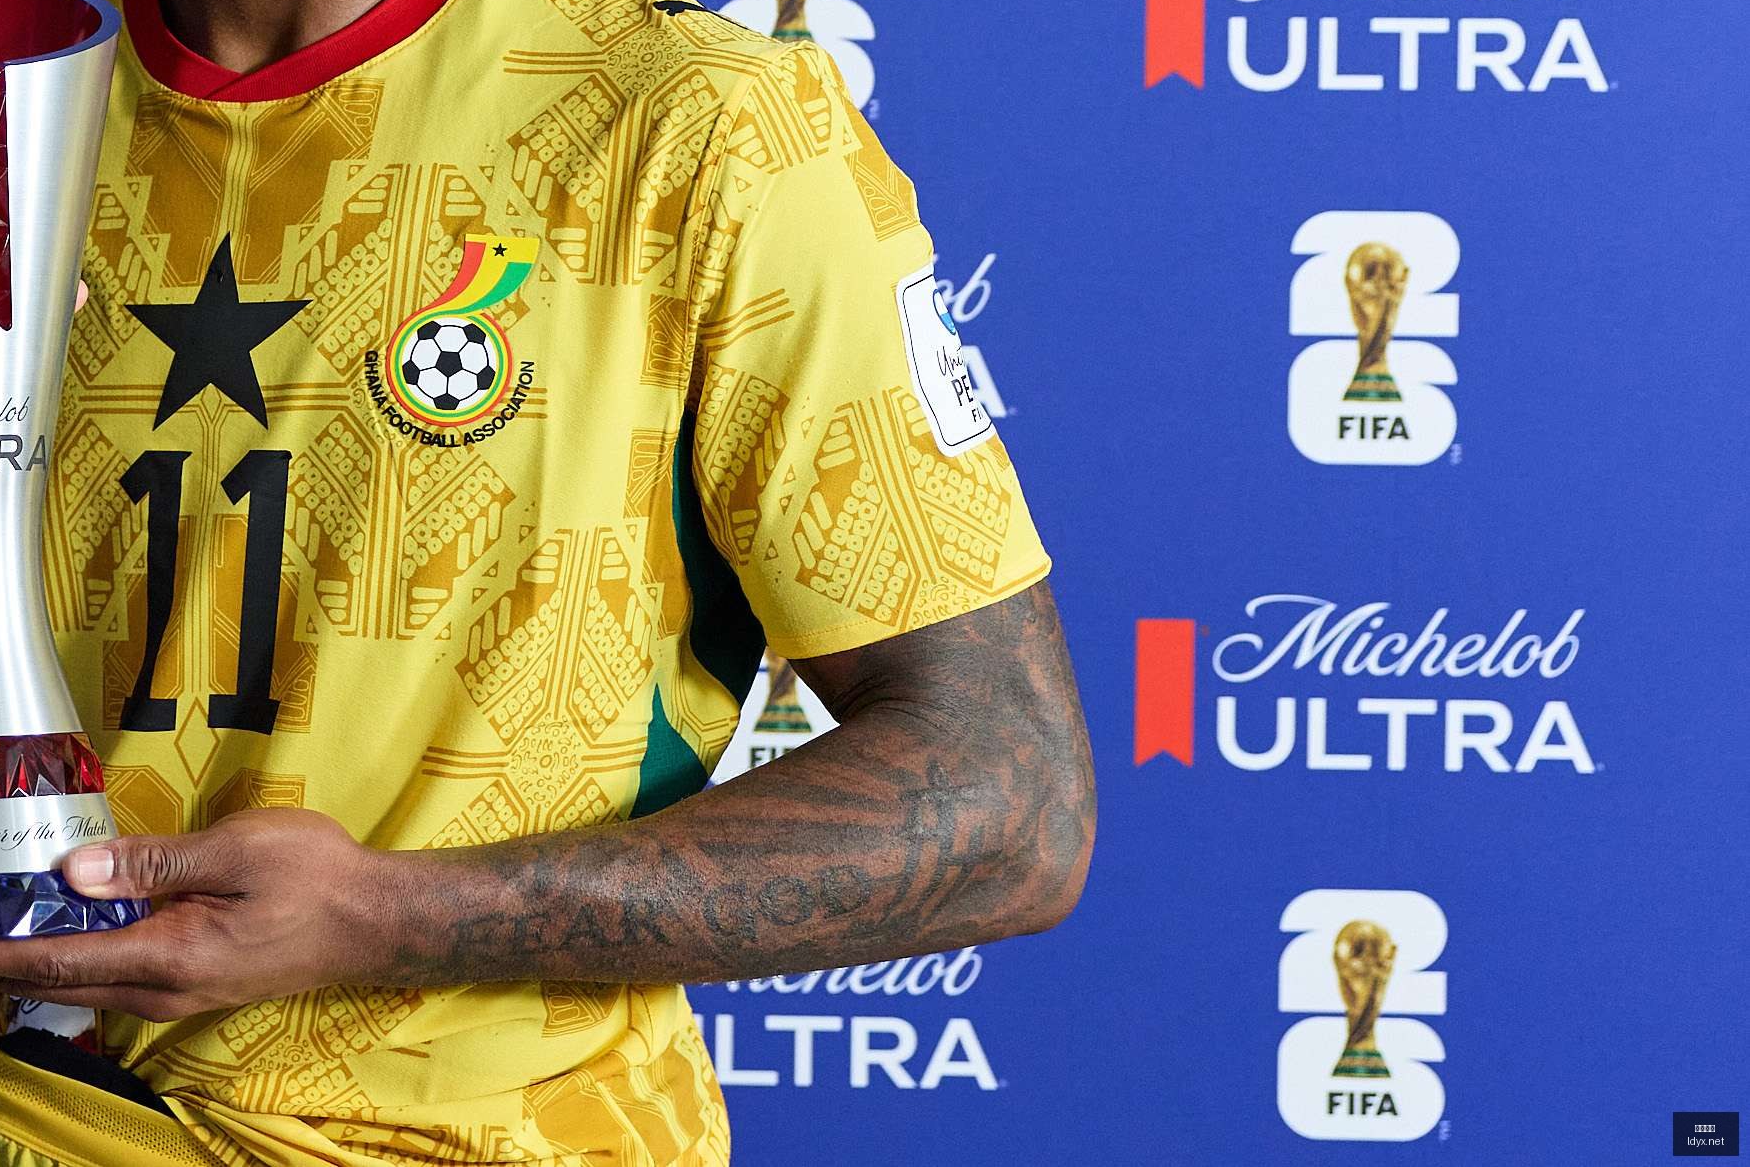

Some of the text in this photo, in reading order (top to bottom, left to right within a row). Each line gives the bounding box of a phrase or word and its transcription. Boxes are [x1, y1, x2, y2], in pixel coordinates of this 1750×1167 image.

[1228, 17, 1608, 92] ULTRA
[364, 350, 535, 448] GHANA FOOTBALL ASSOCIATION
[1339, 416, 1409, 440] FIFA
[119, 450, 292, 736] 11
[1213, 595, 1585, 682] Michelob
[1217, 697, 1595, 773] ULTRA
[1, 827, 32, 851] of
[34, 822, 55, 840] the
[62, 815, 107, 841] Match
[693, 1013, 999, 1090] LTRA
[1328, 1092, 1398, 1116] FIFA
